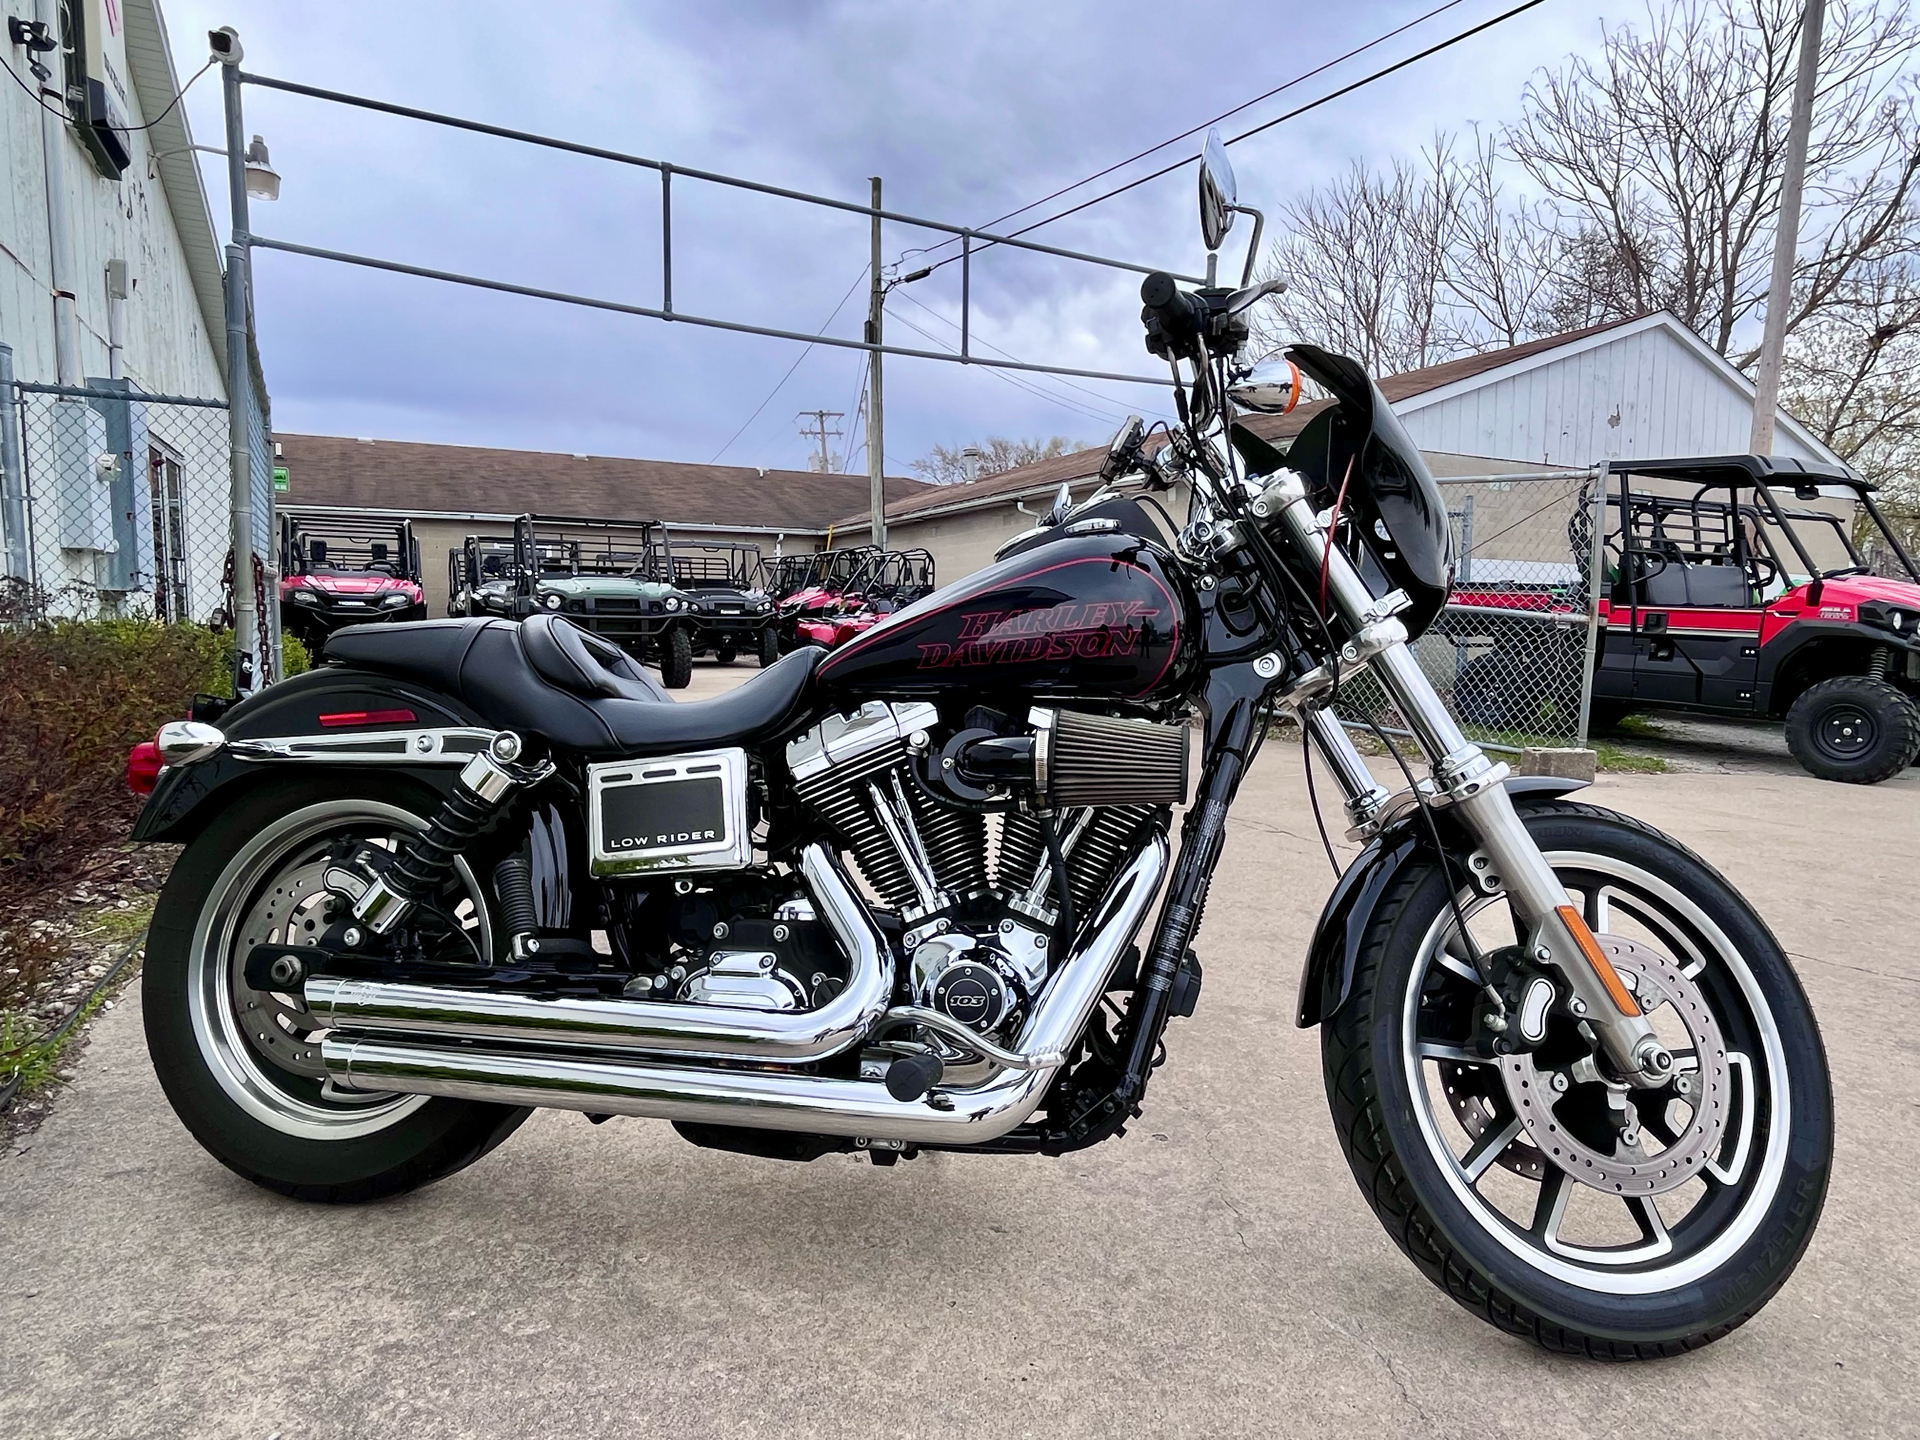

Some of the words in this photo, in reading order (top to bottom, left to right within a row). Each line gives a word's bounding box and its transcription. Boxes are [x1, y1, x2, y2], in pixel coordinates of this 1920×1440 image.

[957, 600, 1160, 640] HARLEY-
[916, 629, 1143, 669] DAVIDSON
[611, 836, 648, 848] LOW
[657, 830, 716, 844] RIDER
[950, 995, 986, 1007] 103
[1716, 1177, 1816, 1311] METZELER
